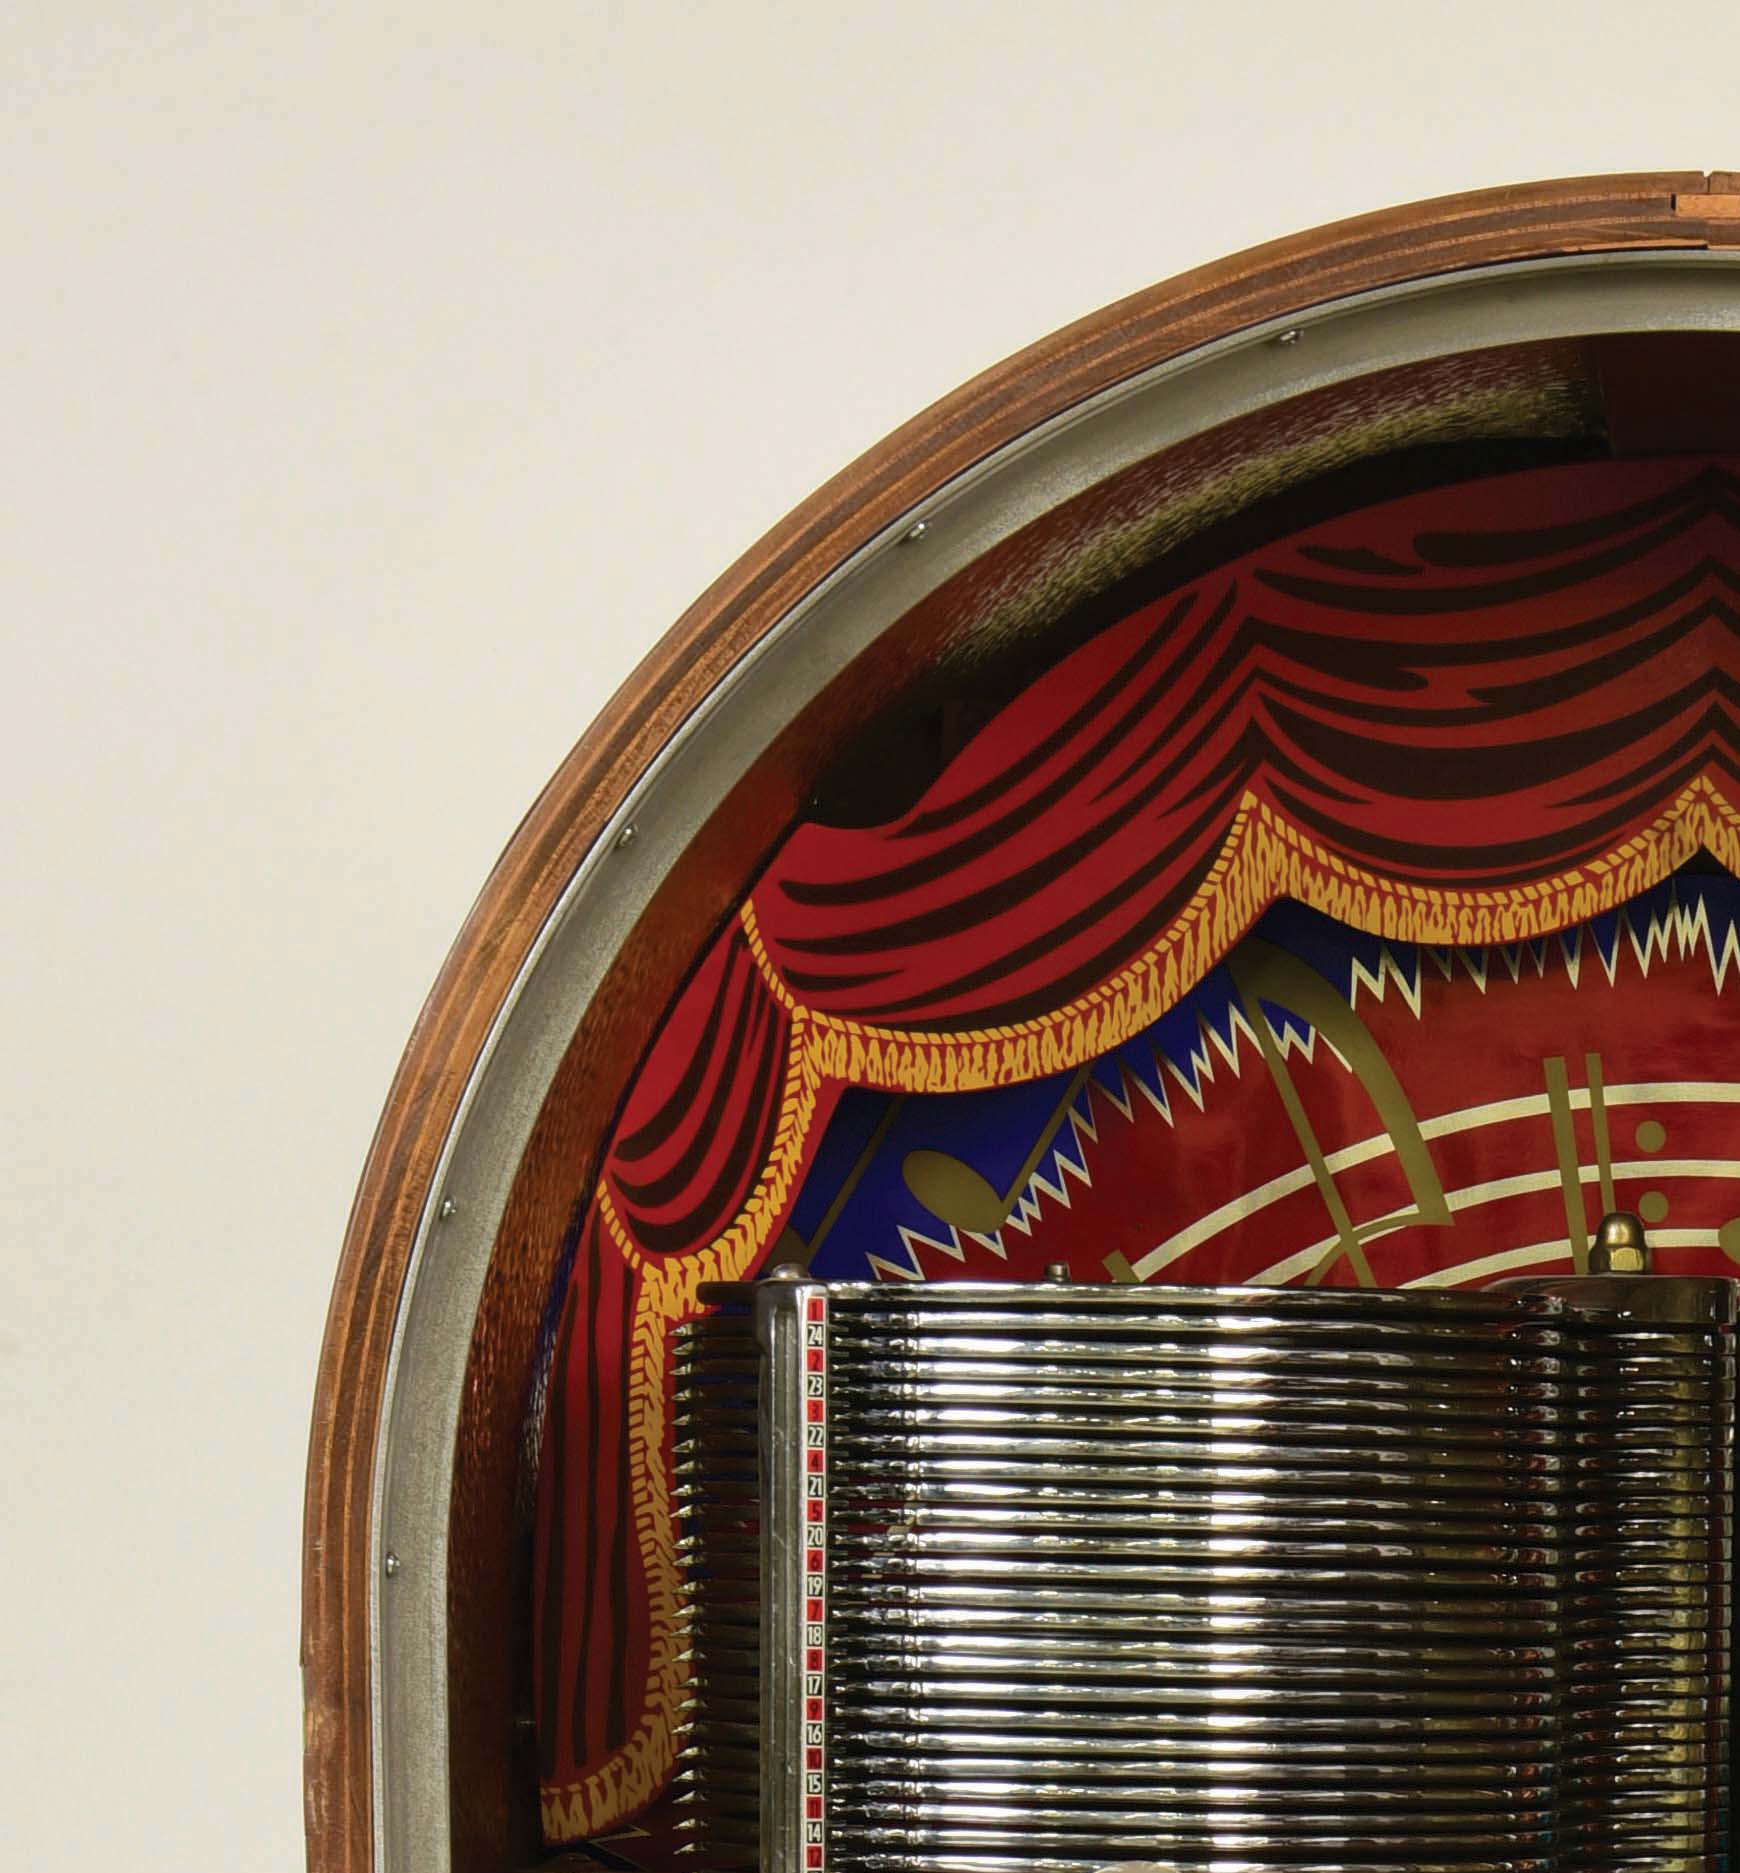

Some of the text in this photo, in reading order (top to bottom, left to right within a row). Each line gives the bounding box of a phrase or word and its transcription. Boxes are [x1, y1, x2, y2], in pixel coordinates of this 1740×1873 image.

[808, 1325, 822, 1345] 24
[808, 1376, 822, 1395] 23
[808, 1427, 822, 1445] 22
[809, 1477, 822, 1496] 21
[808, 1526, 823, 1545] 20
[808, 1576, 822, 1595] 19
[808, 1626, 822, 1645] 18
[808, 1676, 821, 1696] 17
[808, 1725, 822, 1744] 16
[808, 1774, 821, 1792] 15
[810, 1798, 819, 1817] 11
[808, 1823, 821, 1842] 14
